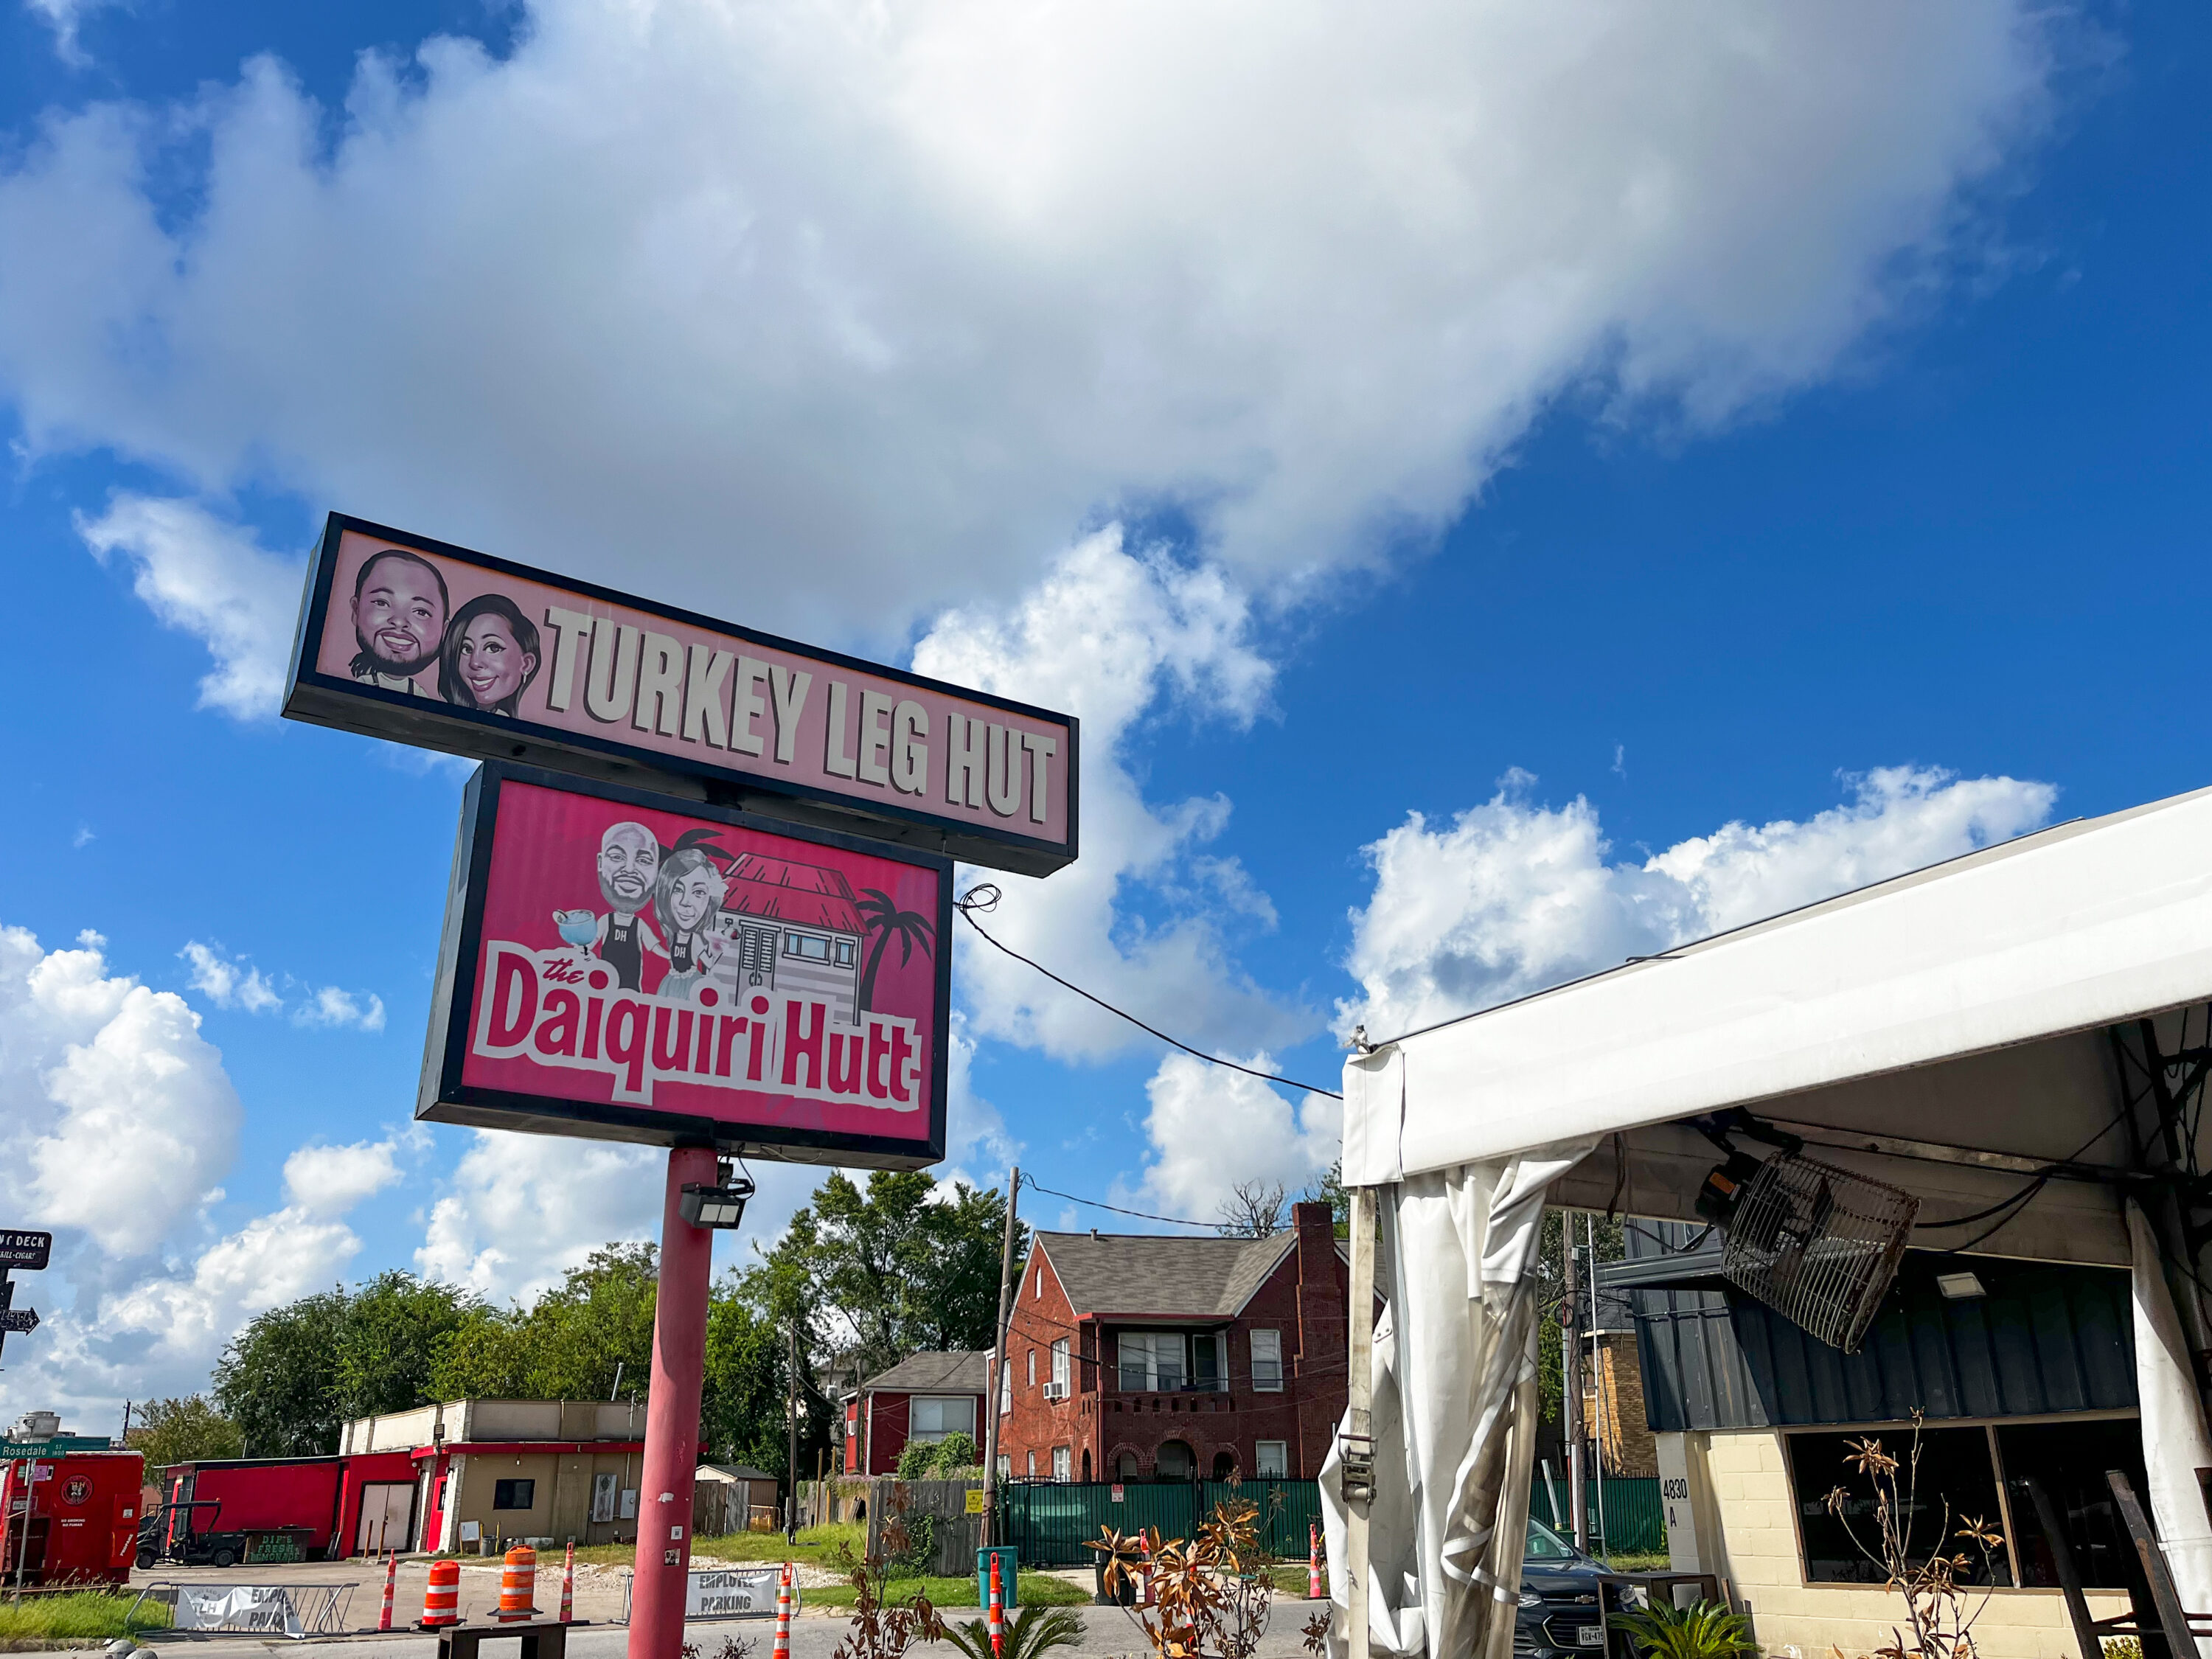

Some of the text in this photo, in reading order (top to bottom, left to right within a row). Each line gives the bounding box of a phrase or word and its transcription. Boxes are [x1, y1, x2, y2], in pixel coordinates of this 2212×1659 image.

[544, 605, 1057, 824] TURKEY LEG HUT
[614, 928, 627, 942] DH
[674, 945, 686, 959] DH
[543, 958, 585, 984] the
[486, 951, 914, 1102] Daiquiri Hutt
[15, 1236, 45, 1247] DECK
[3, 1446, 46, 1455] Rosedale
[1663, 1478, 1688, 1500] 4830
[1669, 1506, 1677, 1528] A
[701, 1596, 751, 1612] PARKING
